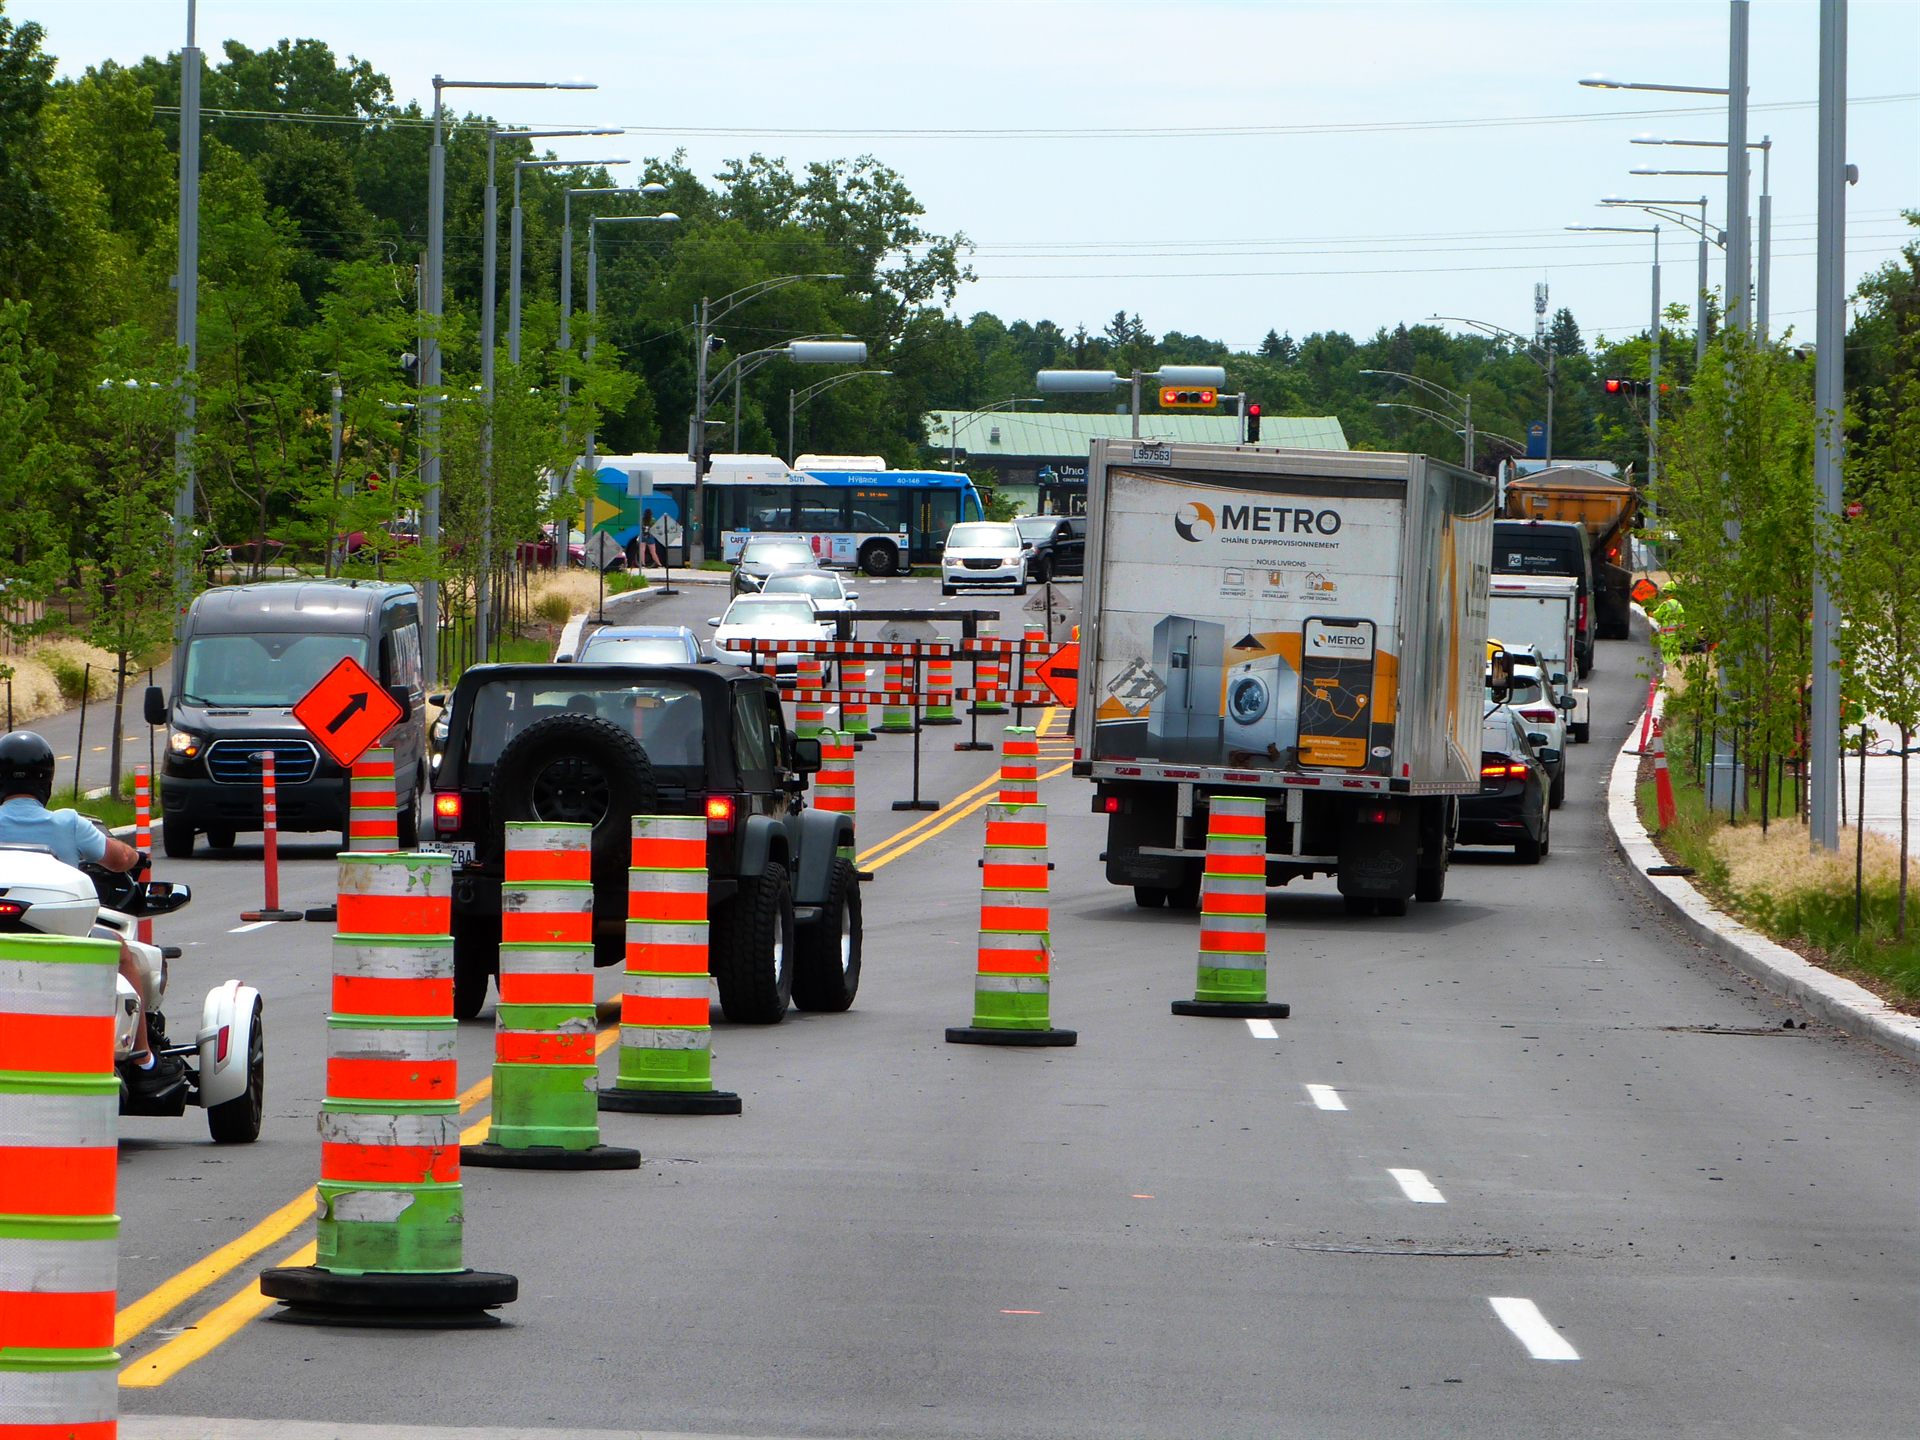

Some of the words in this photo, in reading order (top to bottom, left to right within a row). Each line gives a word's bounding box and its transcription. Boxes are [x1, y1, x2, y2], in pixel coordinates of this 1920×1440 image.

[1133, 449, 1170, 461] L957563
[789, 474, 805, 483] stm
[1221, 504, 1342, 536] METRO
[1251, 538, 1340, 549] D'APPROVISIONNEMENT
[1256, 559, 1277, 567] NOUS
[1277, 560, 1307, 568] LIVRONS
[1327, 634, 1366, 646] METRO
